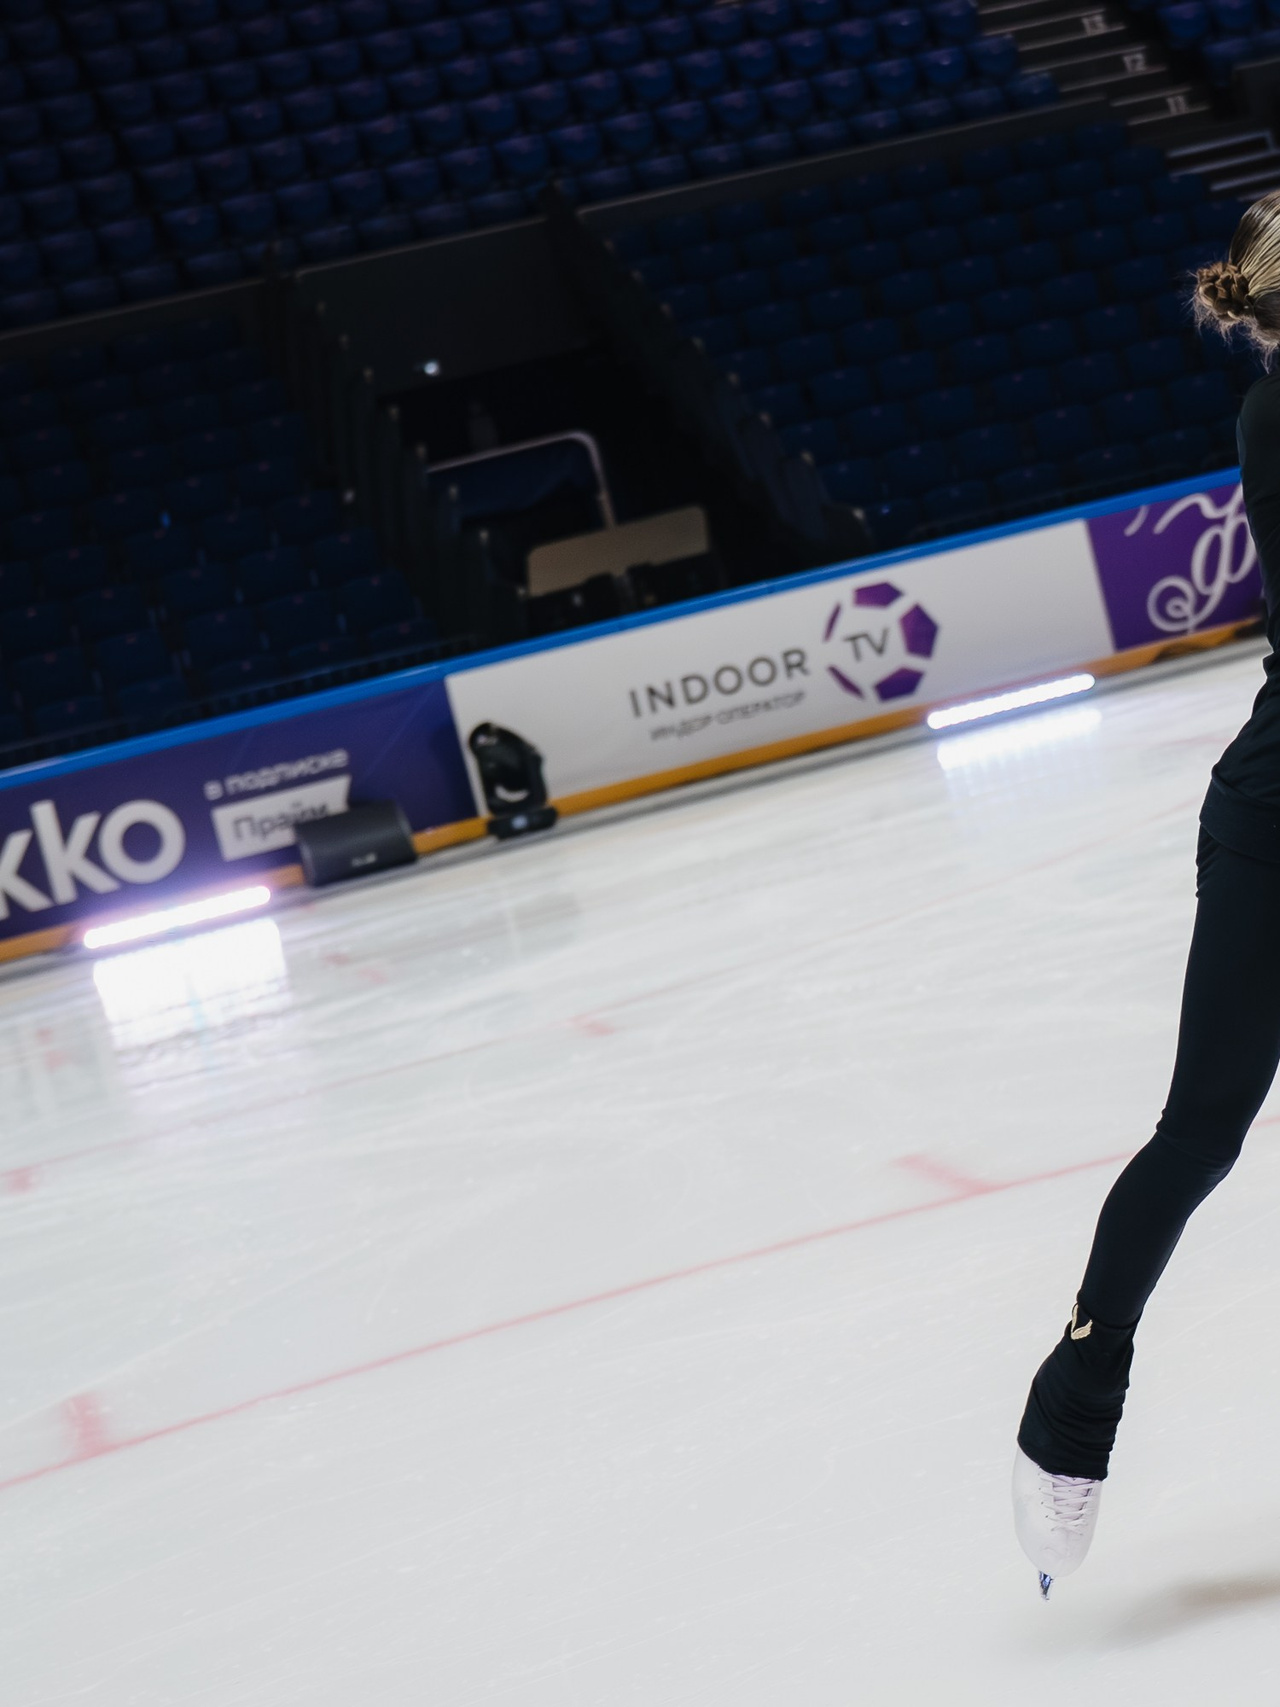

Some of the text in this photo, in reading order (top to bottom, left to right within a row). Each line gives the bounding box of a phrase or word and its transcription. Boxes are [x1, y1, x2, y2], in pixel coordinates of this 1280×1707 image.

[629, 627, 892, 719] INDOOR TV
[225, 748, 349, 796] подписке
